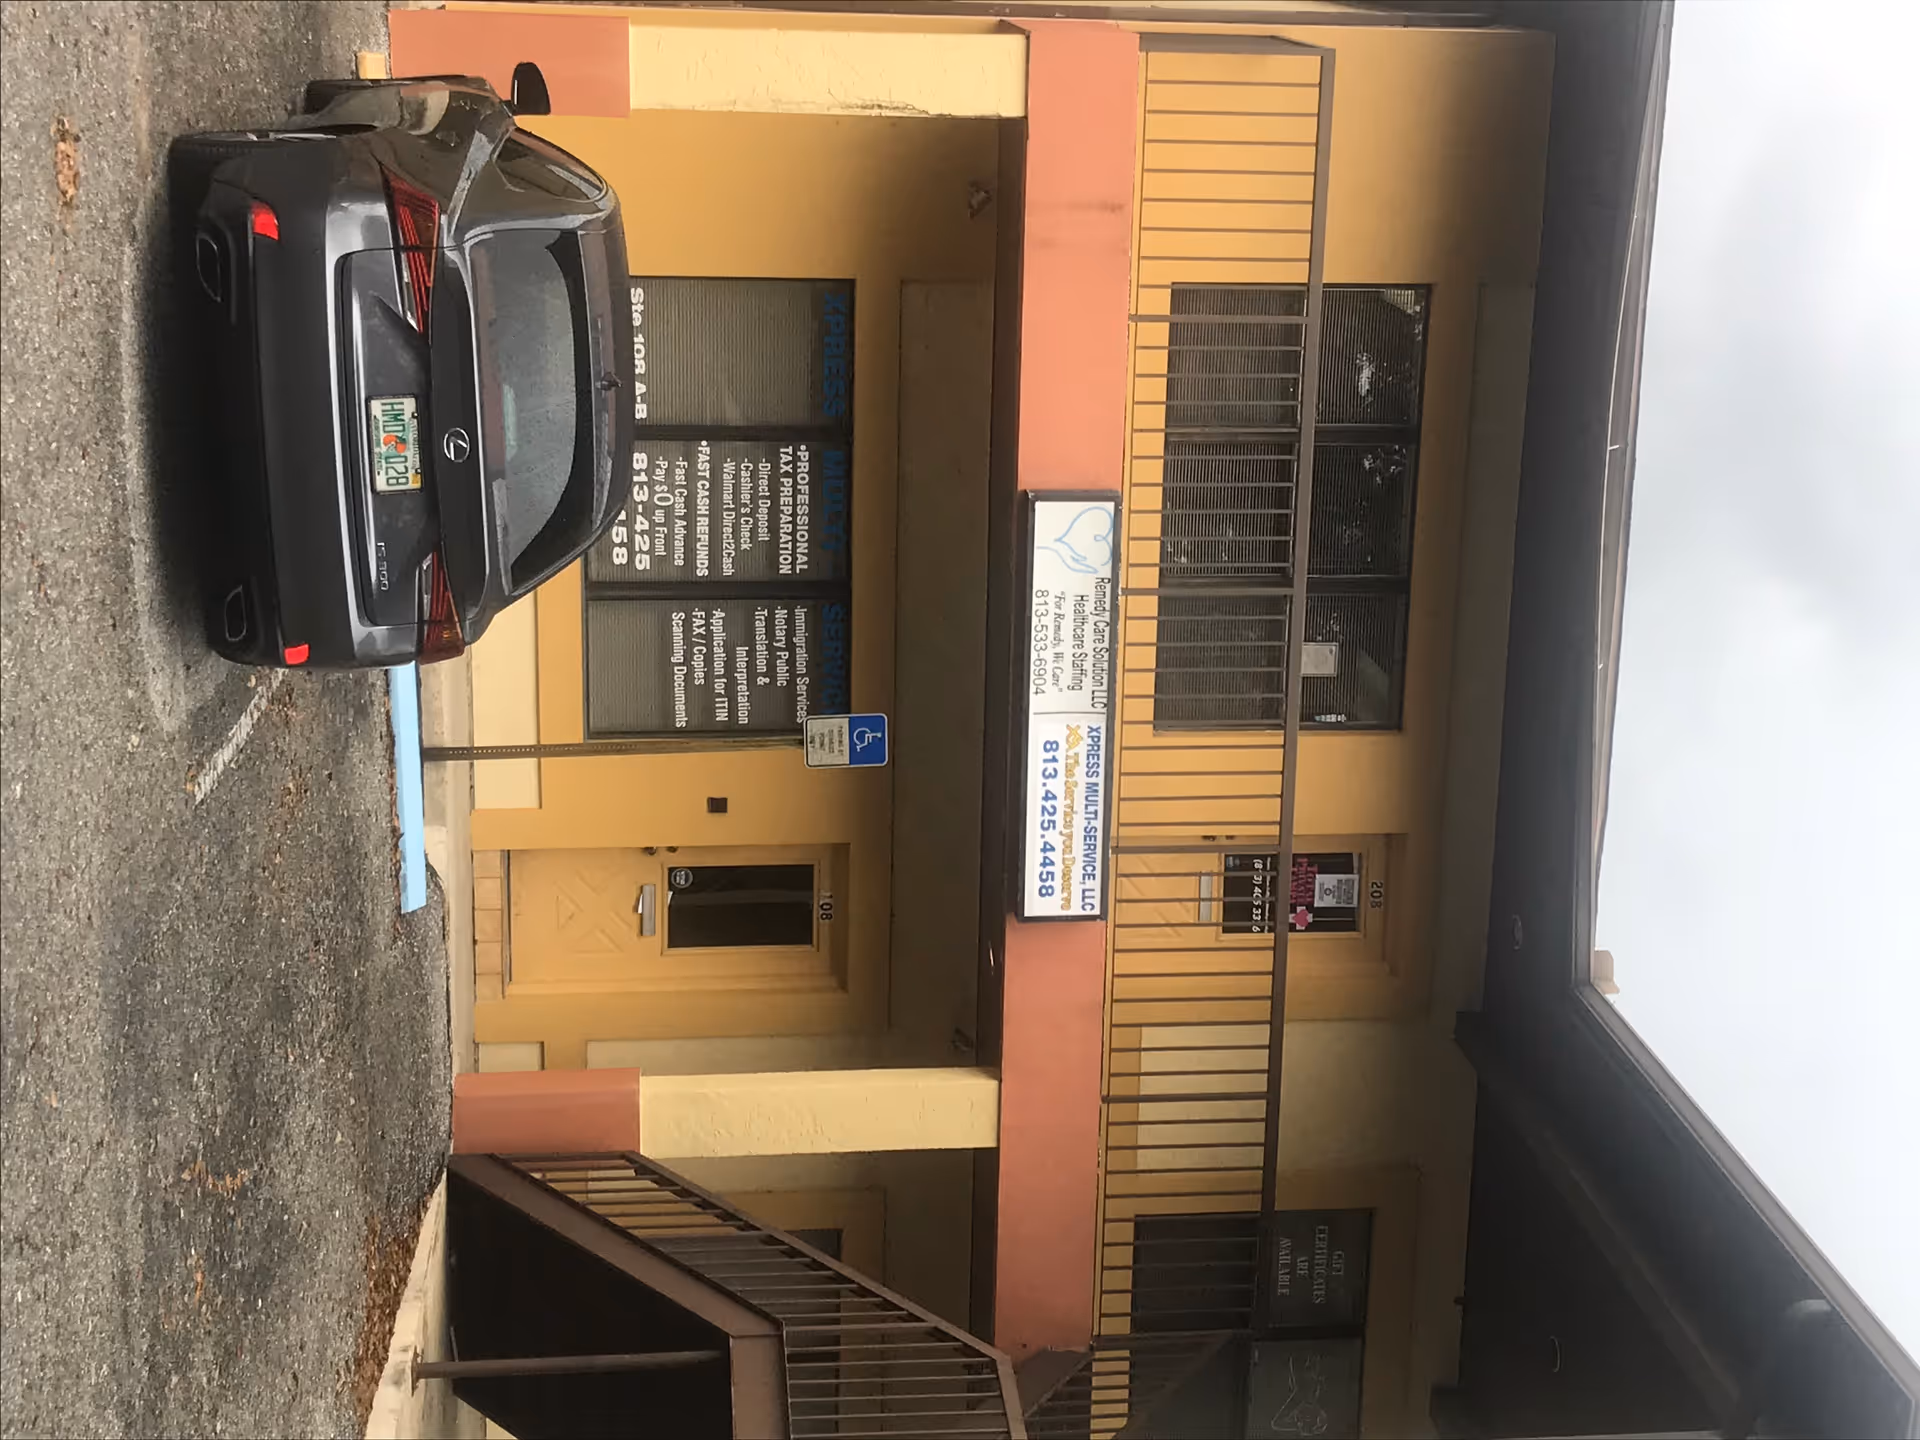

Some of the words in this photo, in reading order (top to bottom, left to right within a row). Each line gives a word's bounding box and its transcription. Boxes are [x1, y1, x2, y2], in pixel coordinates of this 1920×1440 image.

[630, 287, 645, 326] Ste
[632, 333, 647, 375] 108
[822, 291, 847, 417] XPRESS
[634, 381, 648, 420] A-B
[384, 455, 409, 487] 028
[779, 446, 792, 474] TAX
[633, 452, 650, 571] 813-425
[651, 509, 665, 523] up
[674, 489, 687, 517] Cash
[696, 481, 709, 515] CASH
[740, 516, 754, 551] Check
[756, 499, 771, 541] Deposit
[778, 477, 792, 575] PREPARATION
[654, 527, 668, 556] Front
[673, 519, 687, 566] Advance
[696, 516, 709, 577] REFUNDS
[722, 511, 736, 576] Direct2Cash
[1091, 577, 1111, 617] Remedy
[670, 612, 686, 663] Scanning
[1071, 595, 1089, 649] Healthcare
[1091, 620, 1109, 644] Care
[821, 603, 848, 714] SERVIC
[1032, 589, 1049, 695] 813-533-6904
[1052, 651, 1064, 664] We
[691, 646, 707, 686] Copies
[734, 646, 751, 724] Interpretation
[756, 676, 770, 686] &
[775, 651, 789, 687] Public
[1067, 652, 1088, 691] Staffing
[1091, 646, 1108, 687] Solution
[673, 666, 688, 728] Documents
[714, 678, 727, 695] for
[796, 677, 810, 724] Services
[1090, 689, 1107, 709] LLC
[715, 697, 728, 721] ITIN
[1064, 752, 1079, 777] The
[1085, 725, 1101, 778] XPRESS
[1038, 740, 1060, 899] 813.425.4458
[1062, 780, 1078, 830] Service
[1059, 831, 1074, 856] you
[1080, 782, 1099, 886] MULTI-SERVICE,
[1060, 857, 1075, 911] Deserve
[1252, 859, 1263, 885] (83)
[1081, 888, 1096, 911] LLC
[1370, 881, 1383, 909] 208
[1251, 907, 1262, 933] 336
[1277, 1237, 1292, 1296] AVAILABLE
[1296, 1255, 1309, 1278] ARE
[1313, 1225, 1329, 1304] CERTIFICATES
[1332, 1251, 1344, 1276] GIFT
